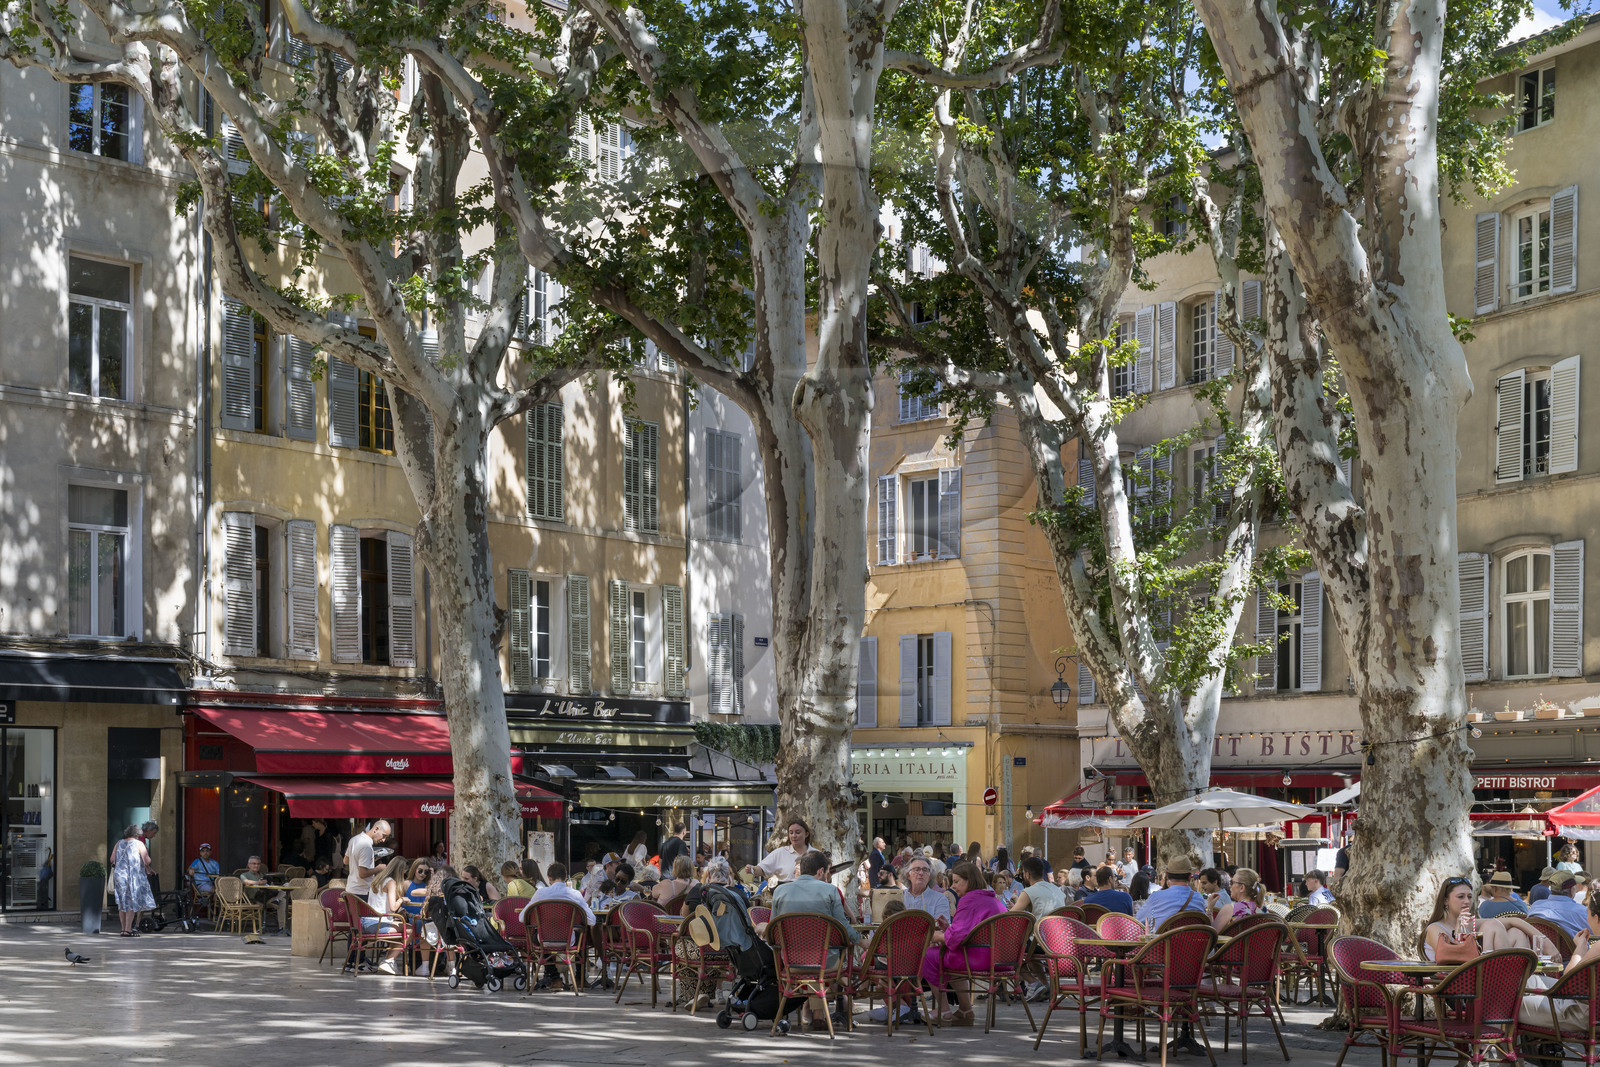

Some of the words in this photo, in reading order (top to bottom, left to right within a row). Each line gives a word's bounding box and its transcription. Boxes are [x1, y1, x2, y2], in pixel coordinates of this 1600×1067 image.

[593, 701, 619, 717] Bar
[556, 732, 591, 744] L'Unic
[595, 733, 612, 744] Bar
[1260, 734, 1357, 757] BISTR
[899, 763, 958, 775] ITALIA
[1477, 777, 1507, 788] PETIT
[1509, 777, 1557, 788] BISTROT
[653, 795, 688, 806] L'Unic
[692, 795, 710, 805] Bar
[530, 805, 538, 813] pub
